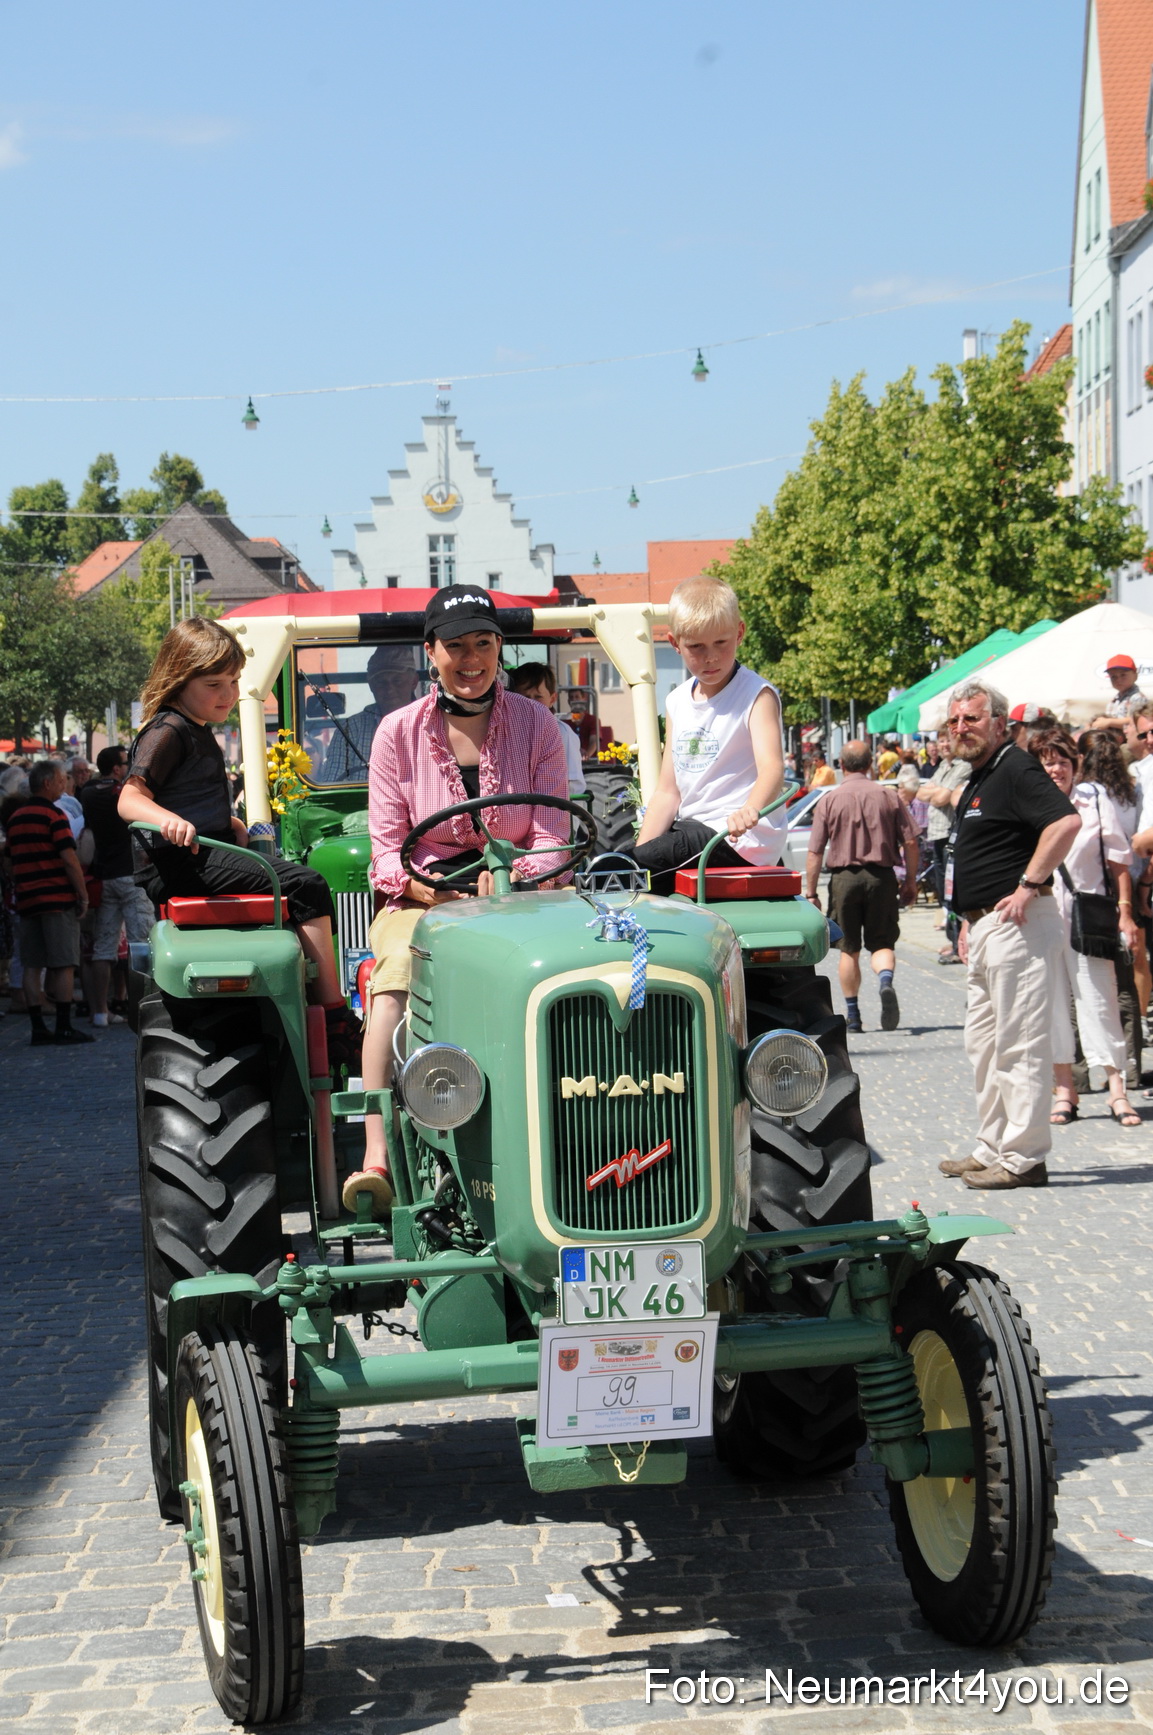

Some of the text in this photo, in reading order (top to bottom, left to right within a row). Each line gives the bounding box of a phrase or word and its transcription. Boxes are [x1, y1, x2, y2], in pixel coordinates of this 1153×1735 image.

[575, 867, 652, 894] MAN
[471, 1179, 496, 1202] 18 PS
[570, 1269, 579, 1280] D
[589, 1250, 635, 1283] NM
[584, 1282, 685, 1319] JK 46
